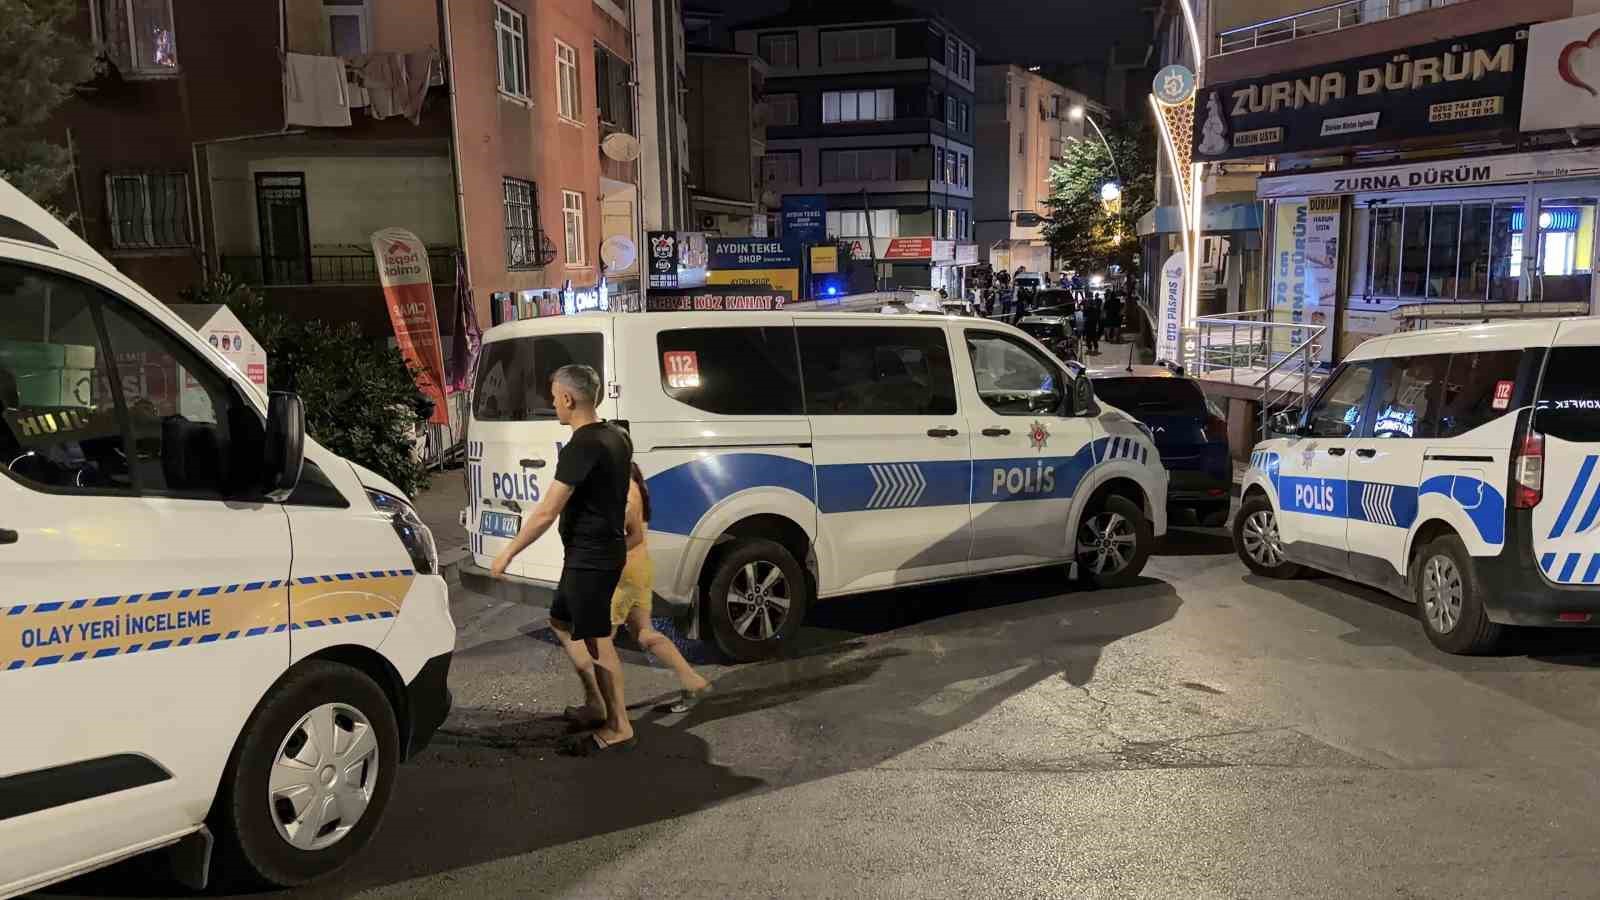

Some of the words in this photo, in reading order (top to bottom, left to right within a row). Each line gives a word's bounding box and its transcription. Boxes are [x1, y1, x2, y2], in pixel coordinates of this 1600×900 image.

[1231, 72, 1346, 117] ZURNA
[1356, 44, 1515, 96] DÜRÜM
[1235, 133, 1258, 145] HARUN
[1259, 130, 1277, 143] USTA
[1334, 172, 1401, 192] ZURNA
[1408, 166, 1491, 186] DÜRÜM
[716, 244, 750, 254] AYDIN
[750, 243, 783, 253] TEKEL
[1291, 205, 1307, 278] DÜRÜM
[738, 255, 762, 264] SHOP
[694, 293, 723, 310] KÖZ
[725, 296, 773, 310] KANAT
[775, 296, 785, 310] 2
[1168, 281, 1178, 320] PASPAS
[1167, 323, 1177, 341] OTO
[669, 355, 692, 371] 112
[1497, 384, 1511, 398] 112
[493, 470, 540, 502] POLİS
[992, 460, 1056, 496] POLİS
[1295, 479, 1335, 513] POLİS
[21, 626, 72, 649] OLAY
[79, 619, 121, 643] YERİ
[125, 608, 211, 636] İNCELEME
